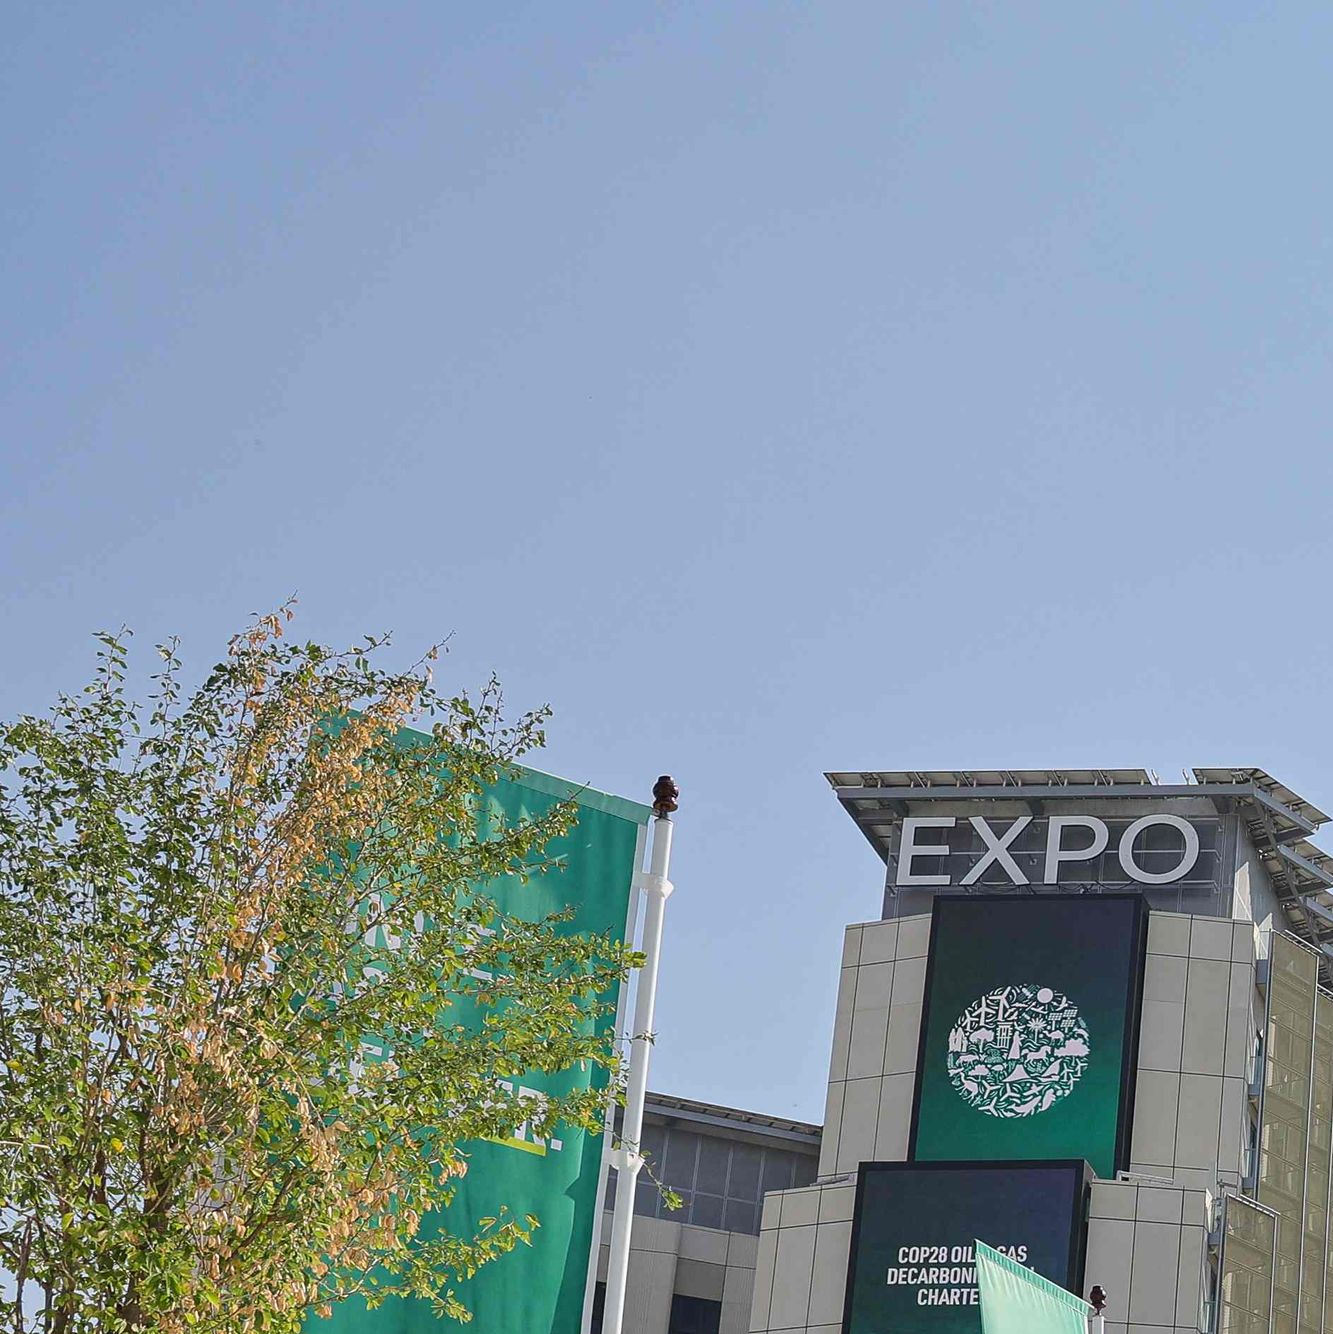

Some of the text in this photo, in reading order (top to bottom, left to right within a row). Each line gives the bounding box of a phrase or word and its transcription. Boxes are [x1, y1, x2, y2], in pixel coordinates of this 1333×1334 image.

[895, 812, 1200, 887] EXPO
[898, 1246, 948, 1264] COP28
[917, 1288, 979, 1305] CHARTE
